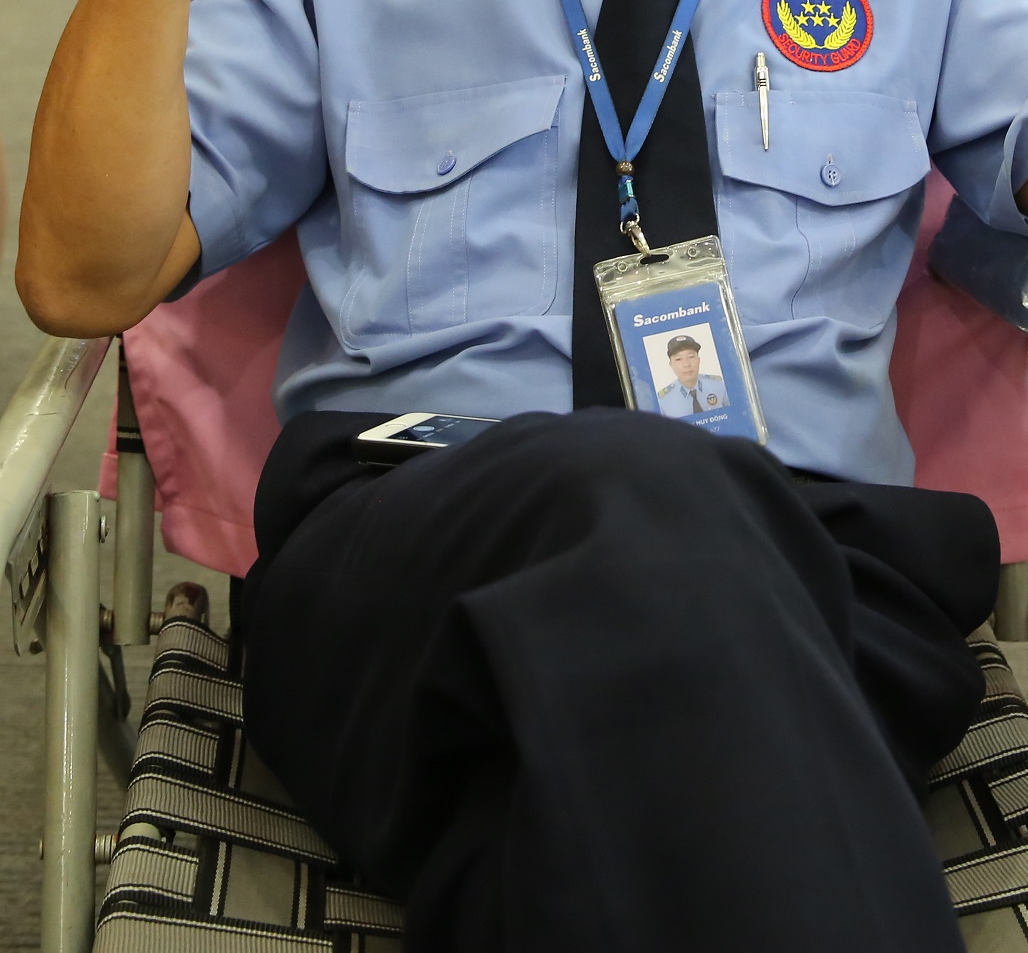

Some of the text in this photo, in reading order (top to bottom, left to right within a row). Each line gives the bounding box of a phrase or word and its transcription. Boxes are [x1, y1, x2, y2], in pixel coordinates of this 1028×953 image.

[576, 28, 602, 83] Sacombank
[653, 29, 684, 84] Sacombank
[633, 302, 711, 327] Sacombank
